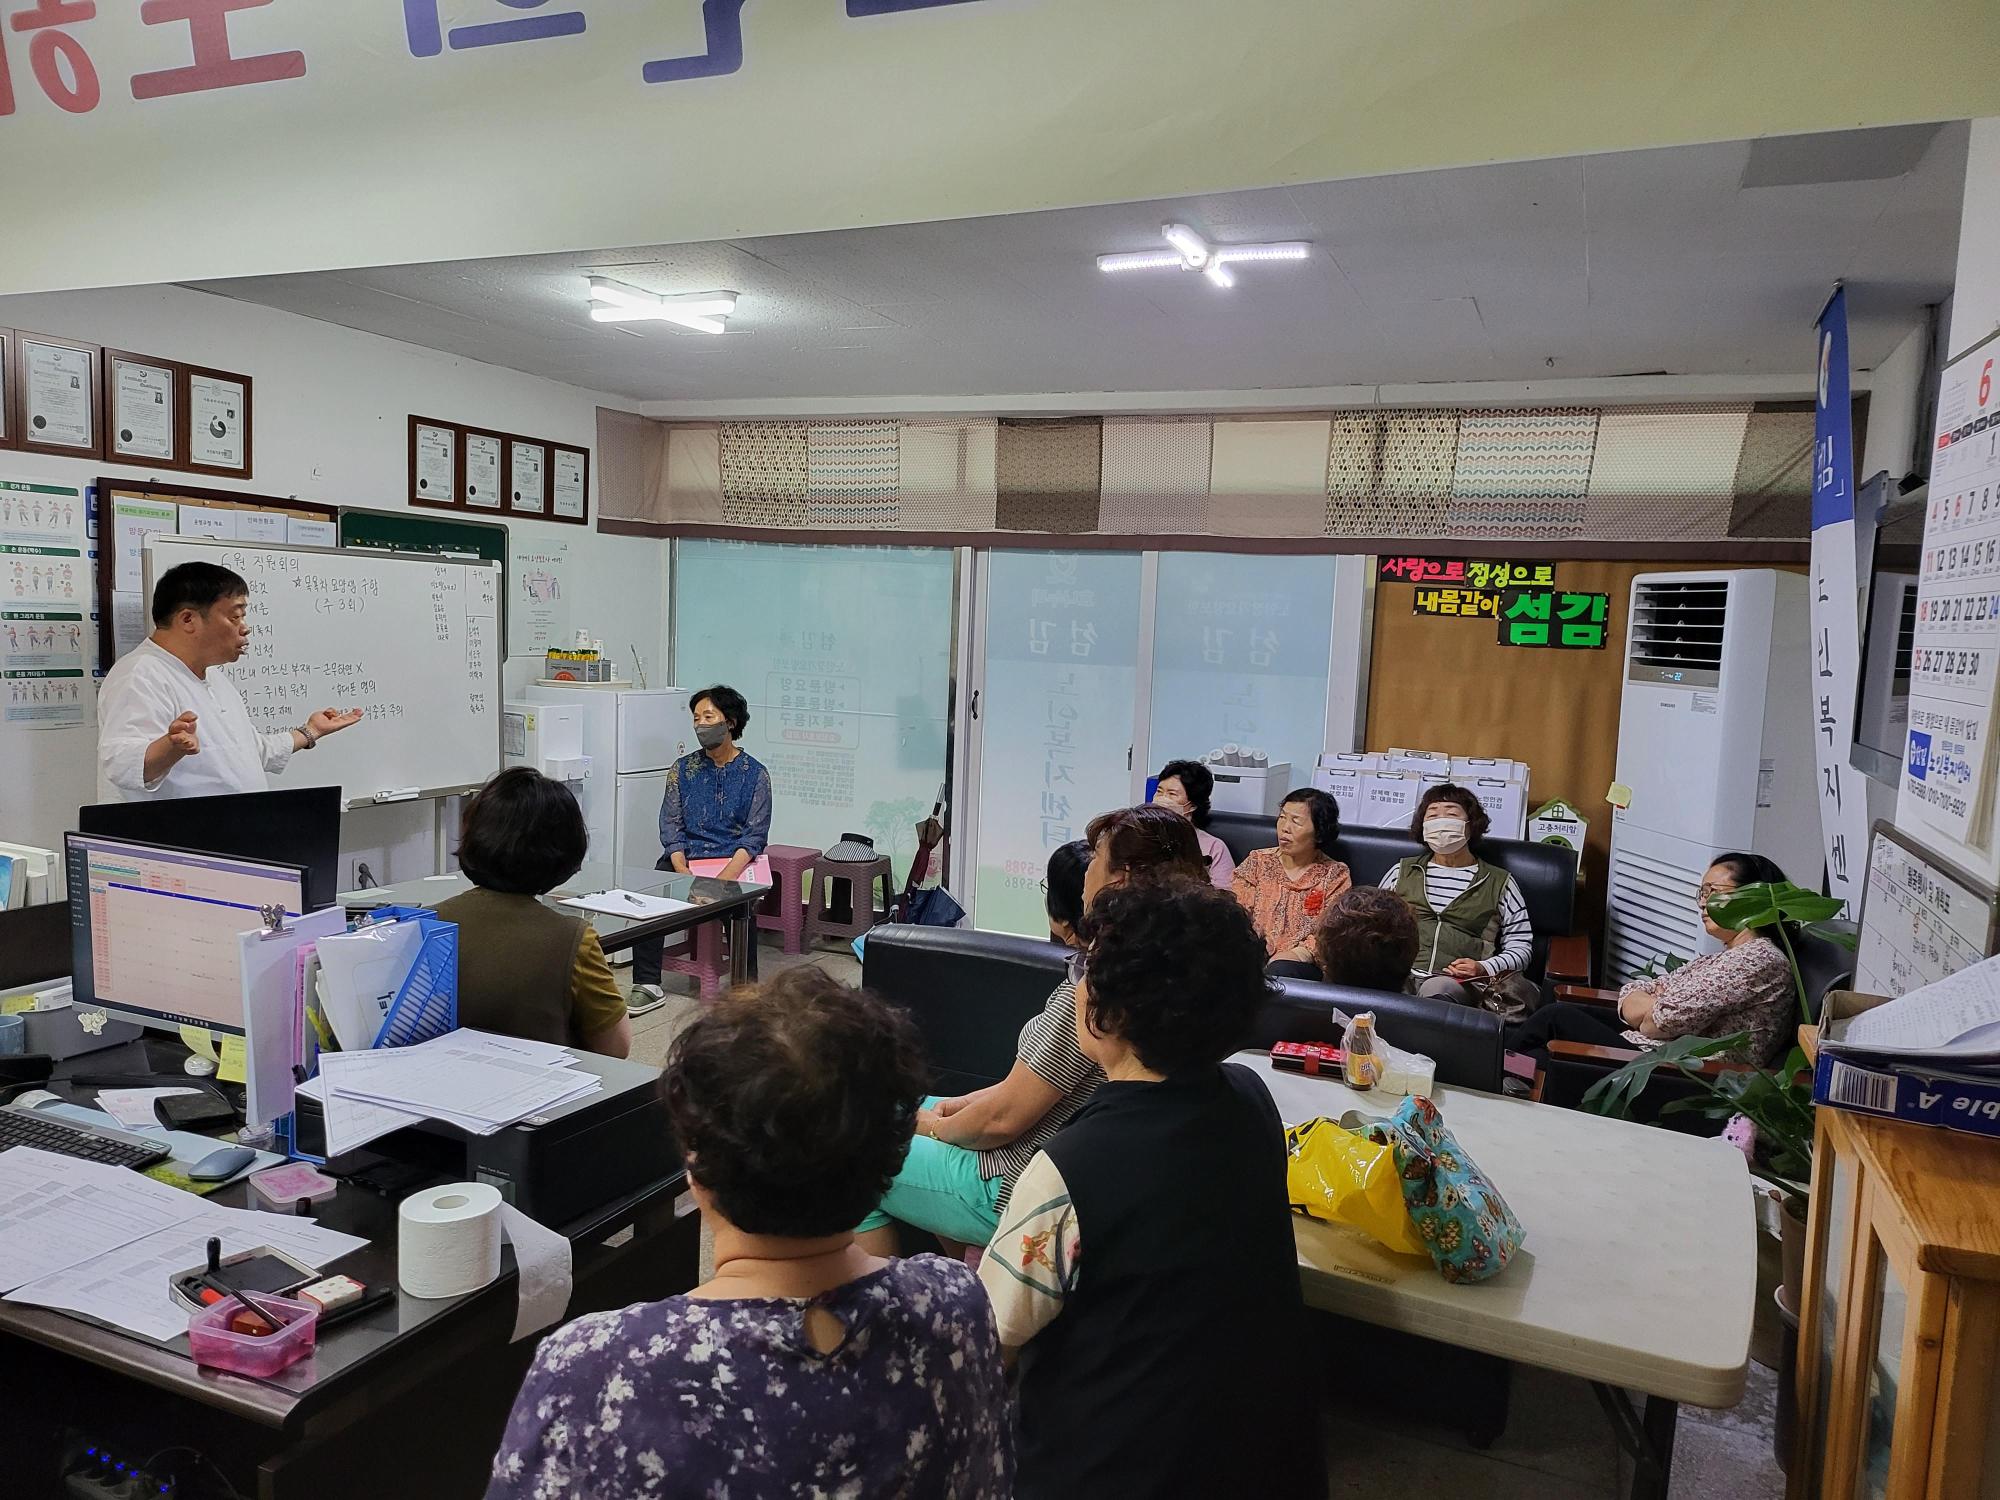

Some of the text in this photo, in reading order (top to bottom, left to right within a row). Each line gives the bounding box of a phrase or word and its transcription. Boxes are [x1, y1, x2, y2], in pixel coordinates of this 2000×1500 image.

[1978, 358, 1993, 407] 6
[1943, 499, 1949, 520] 5
[1955, 494, 1962, 517] 6
[1968, 491, 1976, 515] 7
[1982, 487, 1989, 511] 8
[253, 554, 299, 574] 직원회의
[1926, 539, 1996, 573] 11 12 13 14 15 16
[1382, 557, 1554, 588] 사랑으로 정성으로
[1417, 590, 1499, 616] 내몸같이
[1920, 595, 2000, 621] 18 19 20 21 22 23 24
[1504, 593, 1606, 646] 섬김
[1922, 650, 1932, 671] 26
[1933, 650, 1944, 672] 27
[1944, 651, 1955, 673] 28
[1956, 651, 1967, 675] 29
[1969, 652, 1979, 675] 30
[1928, 752, 1971, 784] 노인복지센터
[1537, 823, 1577, 835] 고충처리함
[1918, 1091, 1944, 1110] A
